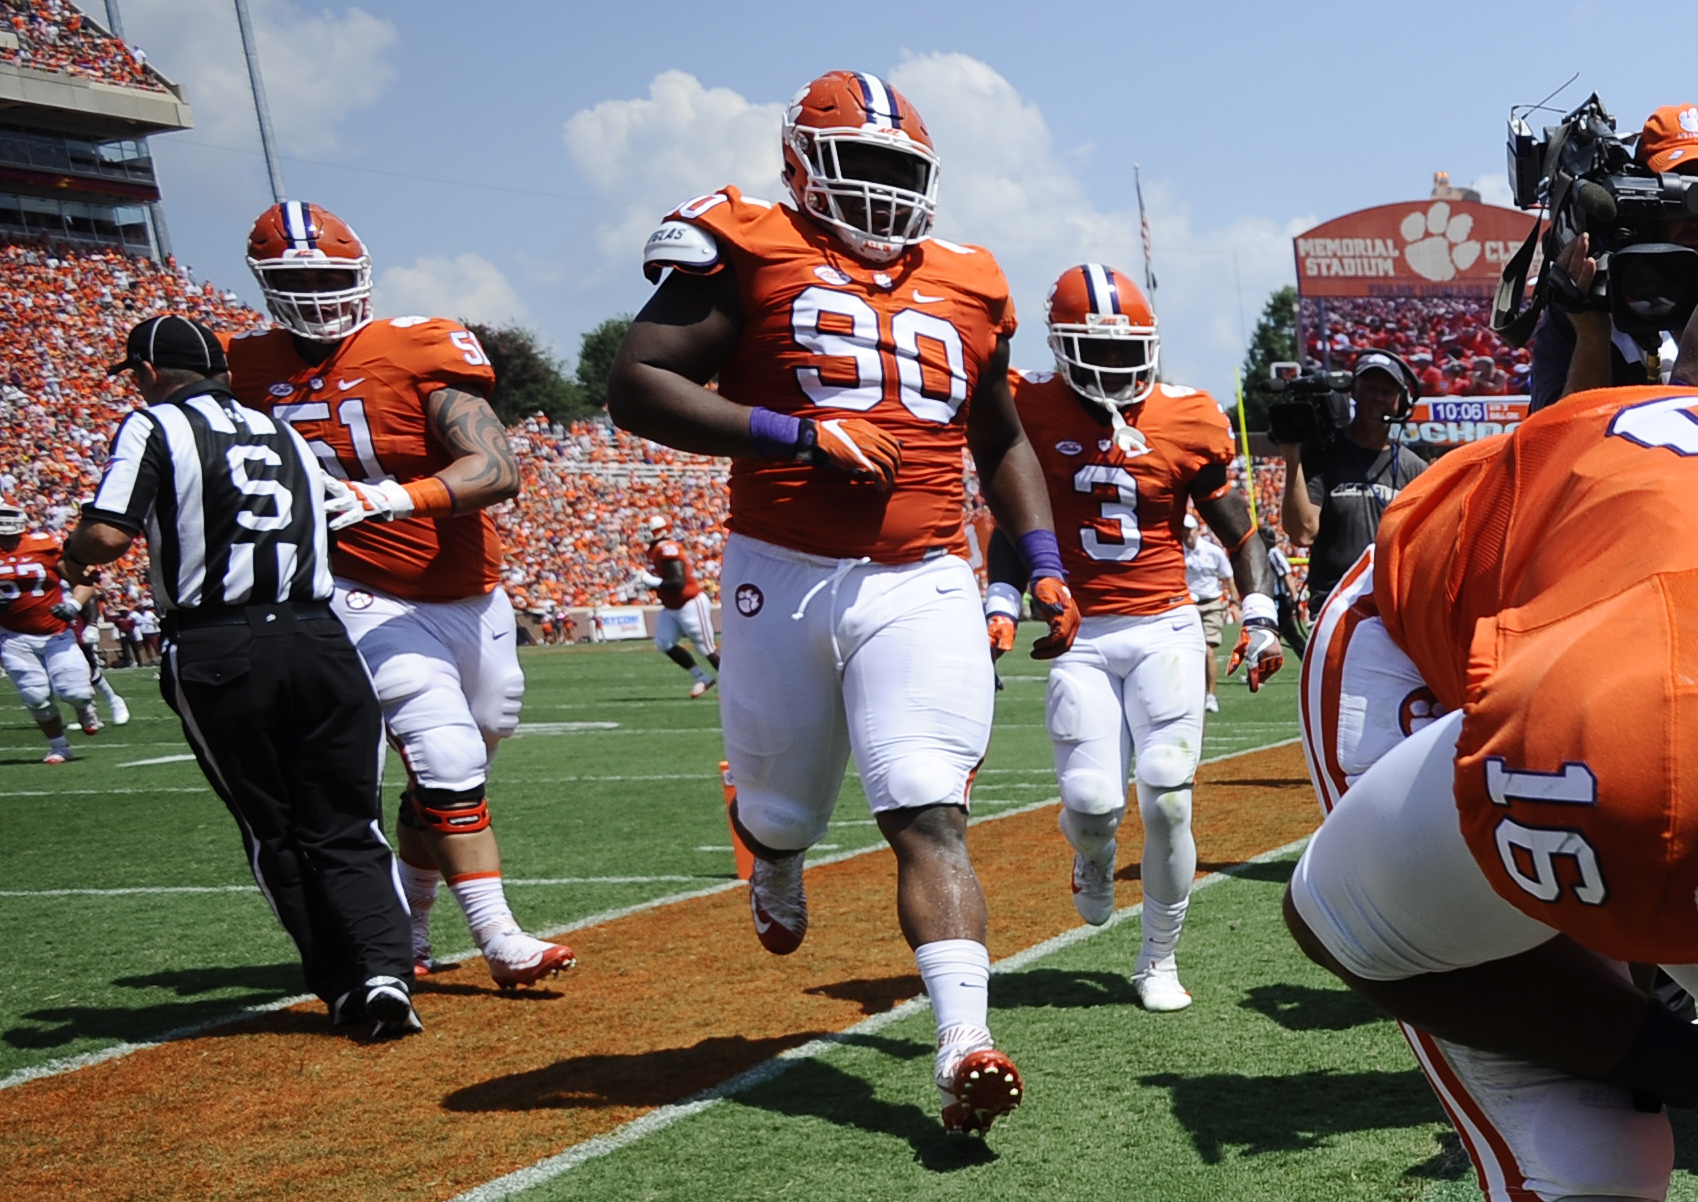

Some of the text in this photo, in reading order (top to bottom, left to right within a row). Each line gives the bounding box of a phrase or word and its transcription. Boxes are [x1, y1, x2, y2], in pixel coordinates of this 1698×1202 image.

[1299, 238, 1400, 258] MEMORIAL
[1306, 258, 1396, 277] STADIUM
[791, 284, 969, 425] 90
[272, 398, 399, 483] 51
[1436, 402, 1482, 421] 10:06
[226, 445, 293, 531] S
[1074, 464, 1141, 561] 3
[1485, 756, 1608, 906] 16
